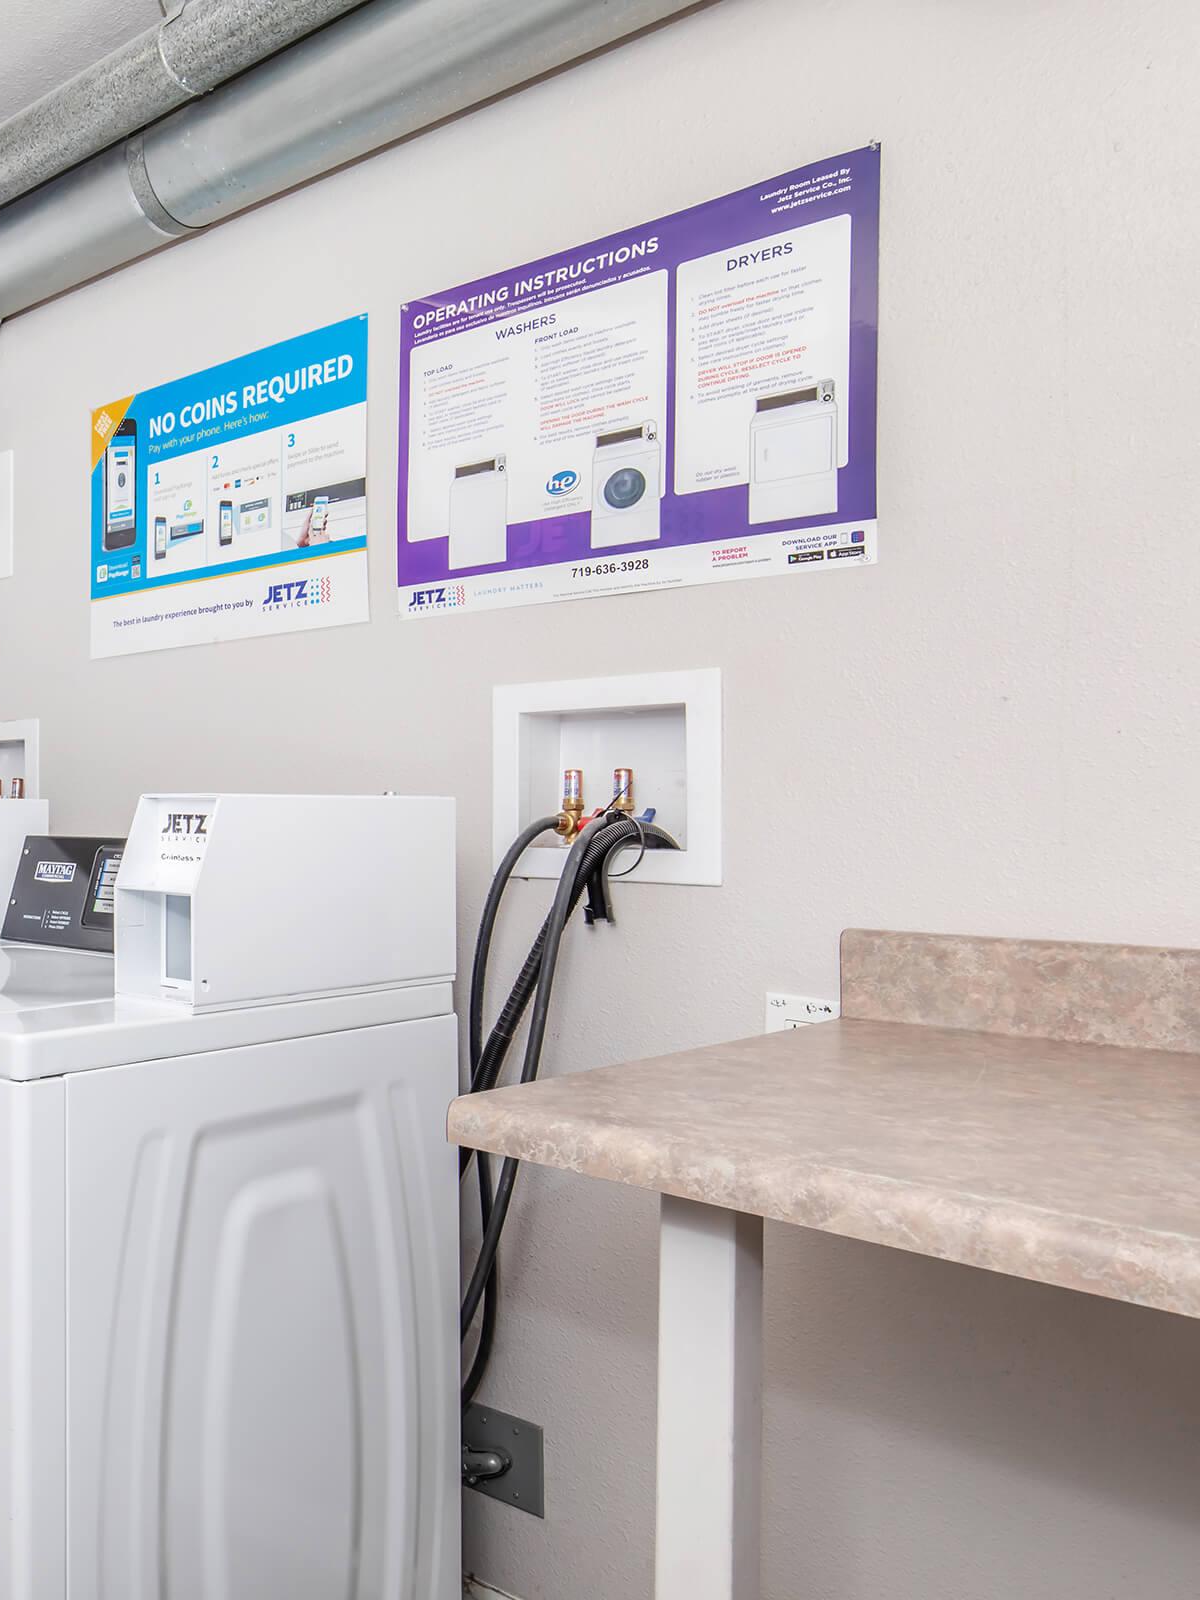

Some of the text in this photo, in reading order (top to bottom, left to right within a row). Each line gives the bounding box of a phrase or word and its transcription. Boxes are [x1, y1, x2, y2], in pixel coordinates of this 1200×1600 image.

[760, 166, 850, 201] Laundry Room Leased By
[777, 174, 852, 204] Jetz Service Co., Inc.
[770, 183, 850, 215] www.jetzservice.com
[726, 241, 792, 271] DRYERS
[413, 236, 658, 330] OPERATING INSTRUCTIONS
[495, 312, 556, 341] WASHERS
[534, 325, 578, 344] FRONT LOAD
[423, 363, 453, 377] TOP LOAD
[149, 409, 175, 438] NO
[179, 389, 236, 429] COINS
[242, 351, 352, 411] REQUIRED
[148, 407, 268, 455] Pay with your phone. Here's how:
[287, 432, 295, 448] 3
[211, 454, 219, 469] 2
[154, 471, 160, 485] 1
[722, 546, 746, 554] REPORT
[782, 536, 820, 546] DOWNLOAD
[795, 542, 821, 551] SERVICE
[718, 552, 748, 560] PROBLEM
[572, 558, 648, 578] 719-636-3928
[262, 580, 307, 604] JETZ
[408, 588, 445, 606] JETZ
[113, 597, 253, 628] The best in laundry experience brought to you by
[262, 600, 307, 612] SERVICE
[161, 813, 209, 834] JETZ
[38, 863, 73, 875] MAYTAG
